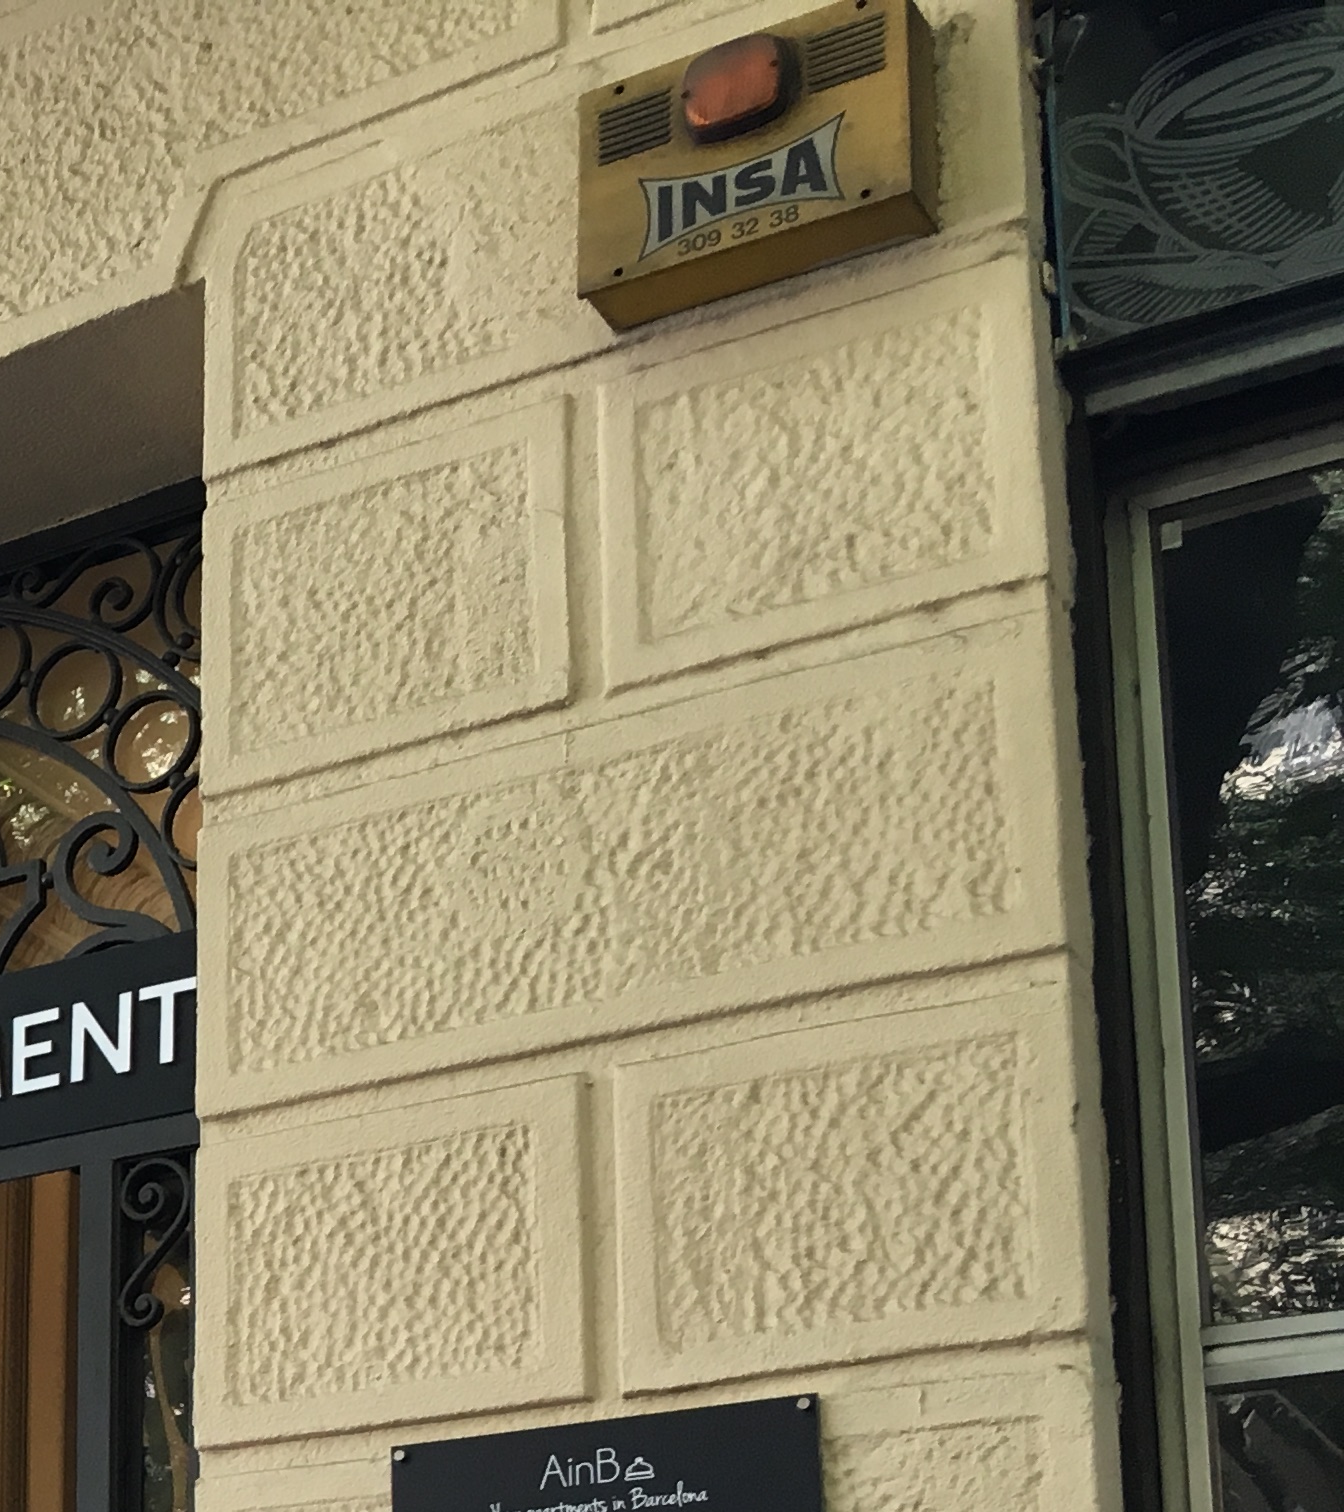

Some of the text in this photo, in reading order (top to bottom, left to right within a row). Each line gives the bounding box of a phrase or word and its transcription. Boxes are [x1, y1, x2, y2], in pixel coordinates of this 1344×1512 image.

[657, 136, 828, 243] INSA
[677, 204, 800, 256] 309 32 38
[538, 1447, 621, 1491] AinB
[612, 1496, 626, 1511] in
[628, 1480, 709, 1511] Barcelona
